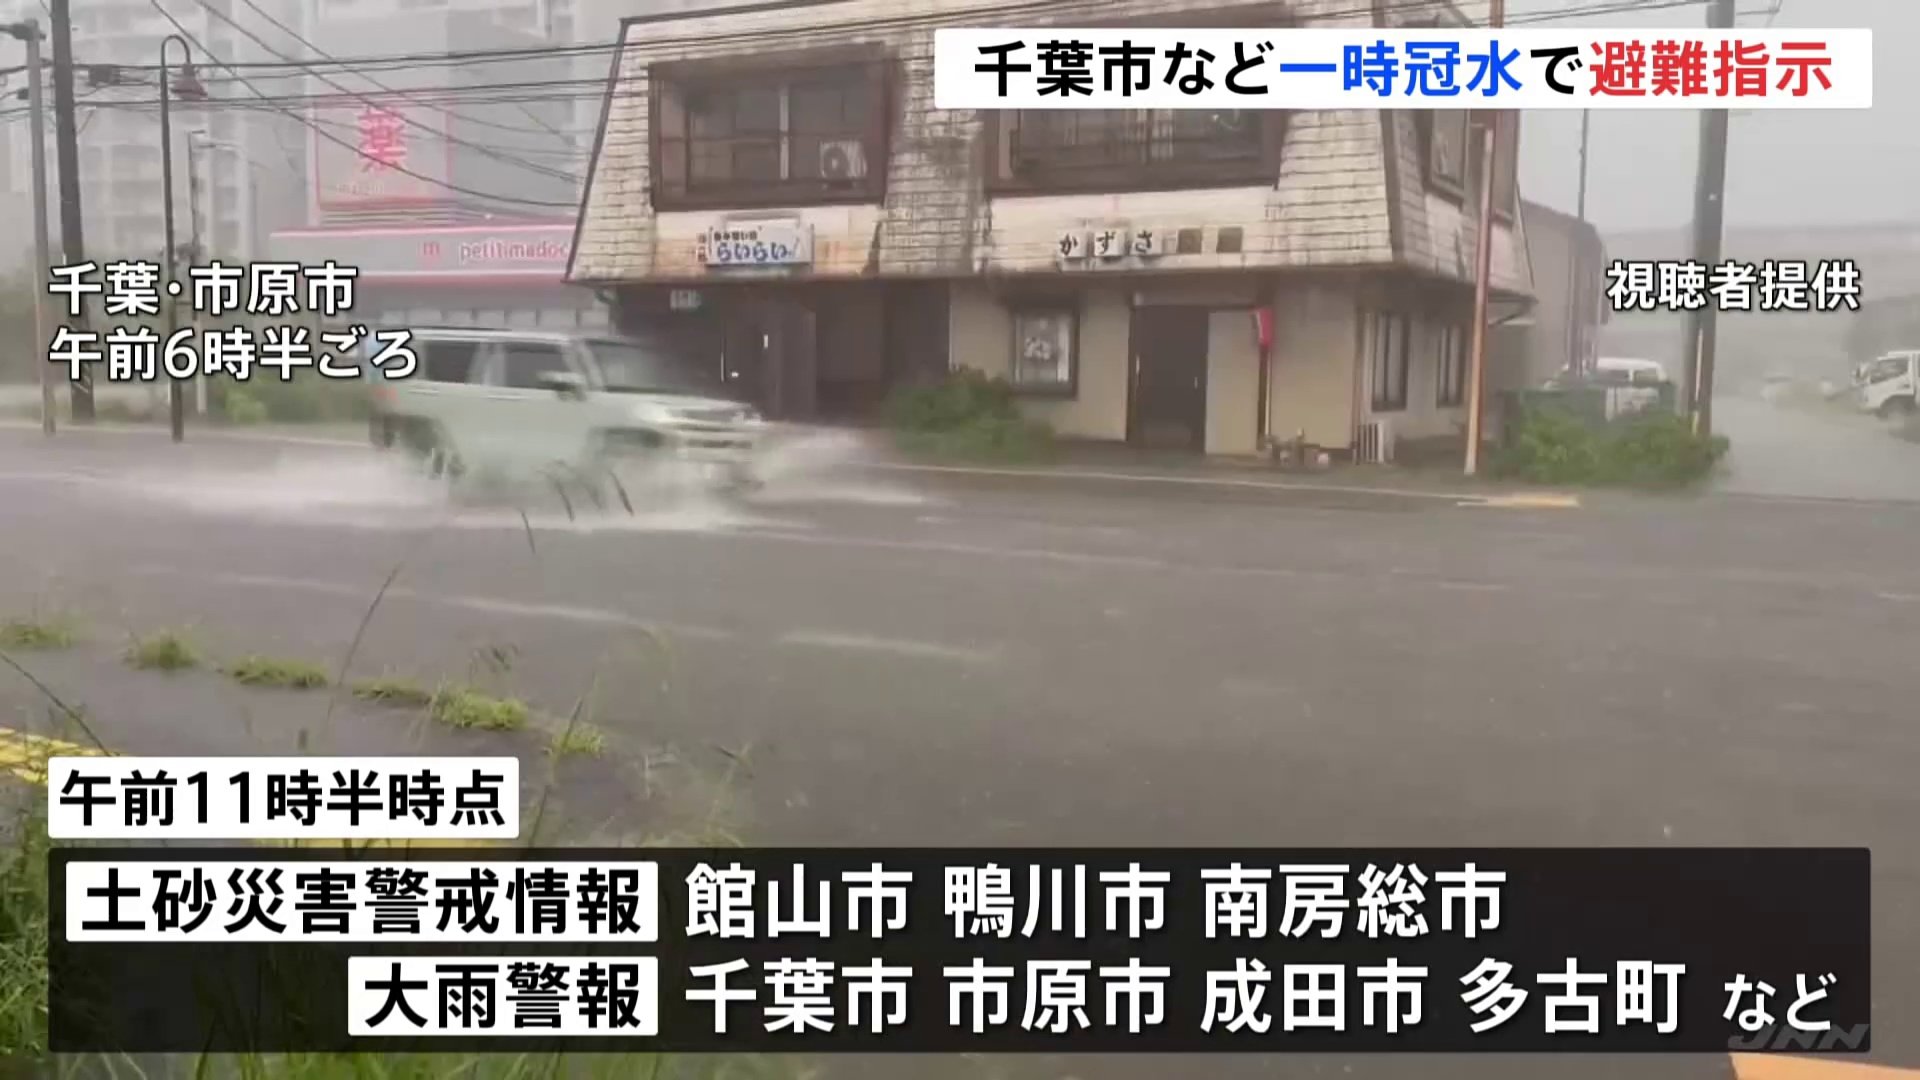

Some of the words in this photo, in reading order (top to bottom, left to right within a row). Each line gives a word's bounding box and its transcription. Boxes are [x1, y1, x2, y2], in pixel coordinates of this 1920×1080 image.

[358, 107, 407, 172] 薬
[1059, 229, 1153, 256] かずさ
